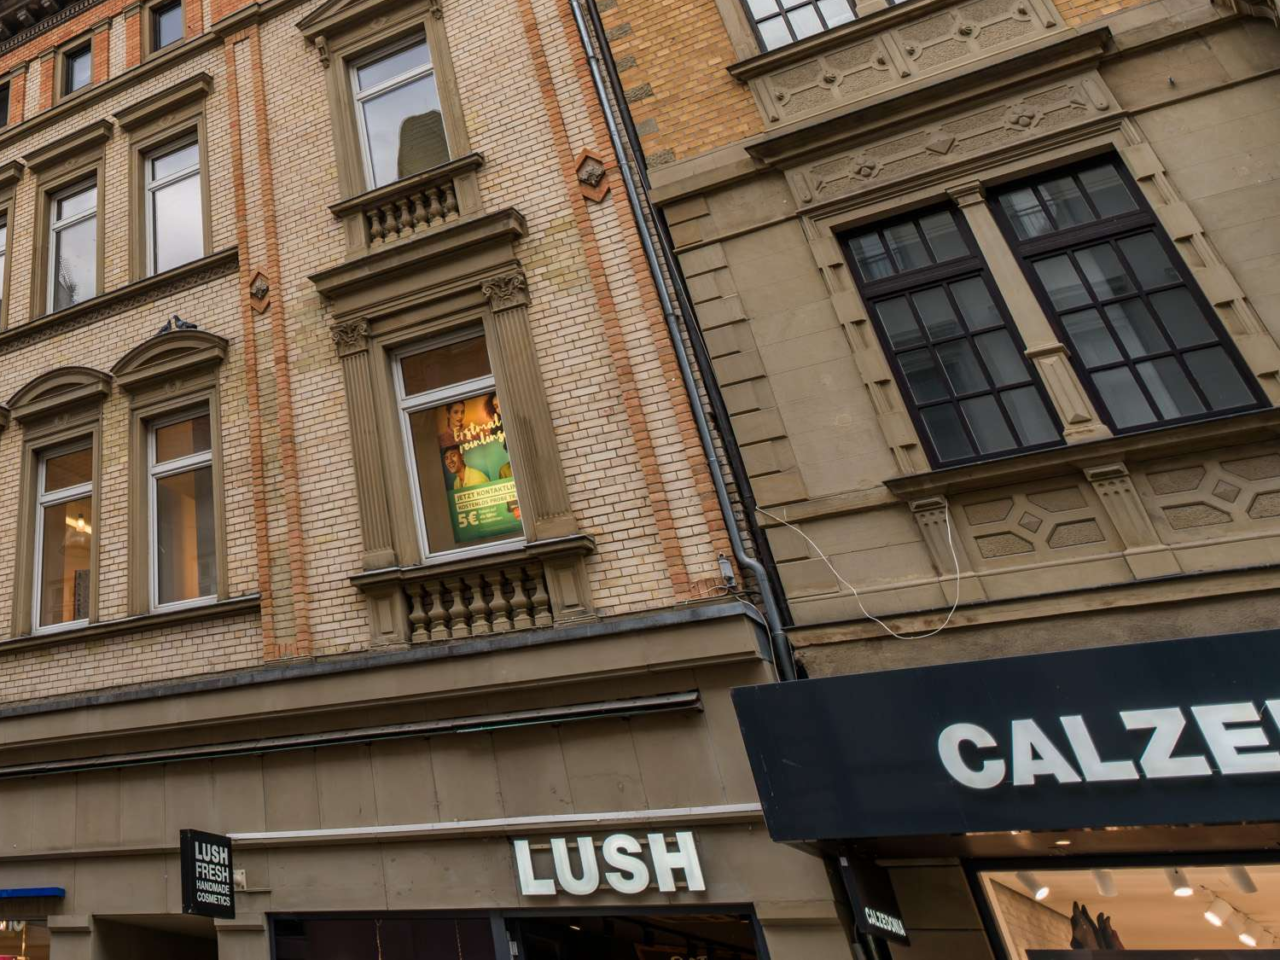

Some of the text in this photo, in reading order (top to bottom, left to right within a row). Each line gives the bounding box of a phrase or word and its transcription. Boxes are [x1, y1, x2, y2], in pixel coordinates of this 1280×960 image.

[459, 430, 507, 454] reinlins
[455, 490, 476, 502] JETZT
[458, 499, 489, 511] KOSTENLOS
[457, 511, 479, 528] 5€
[195, 842, 229, 865] LUSH
[196, 862, 230, 883] FRESH
[513, 831, 706, 896] LUSH
[196, 879, 230, 894] HANDMADE
[197, 891, 231, 907] COSMETICS
[865, 907, 906, 936] CALZEDONIA
